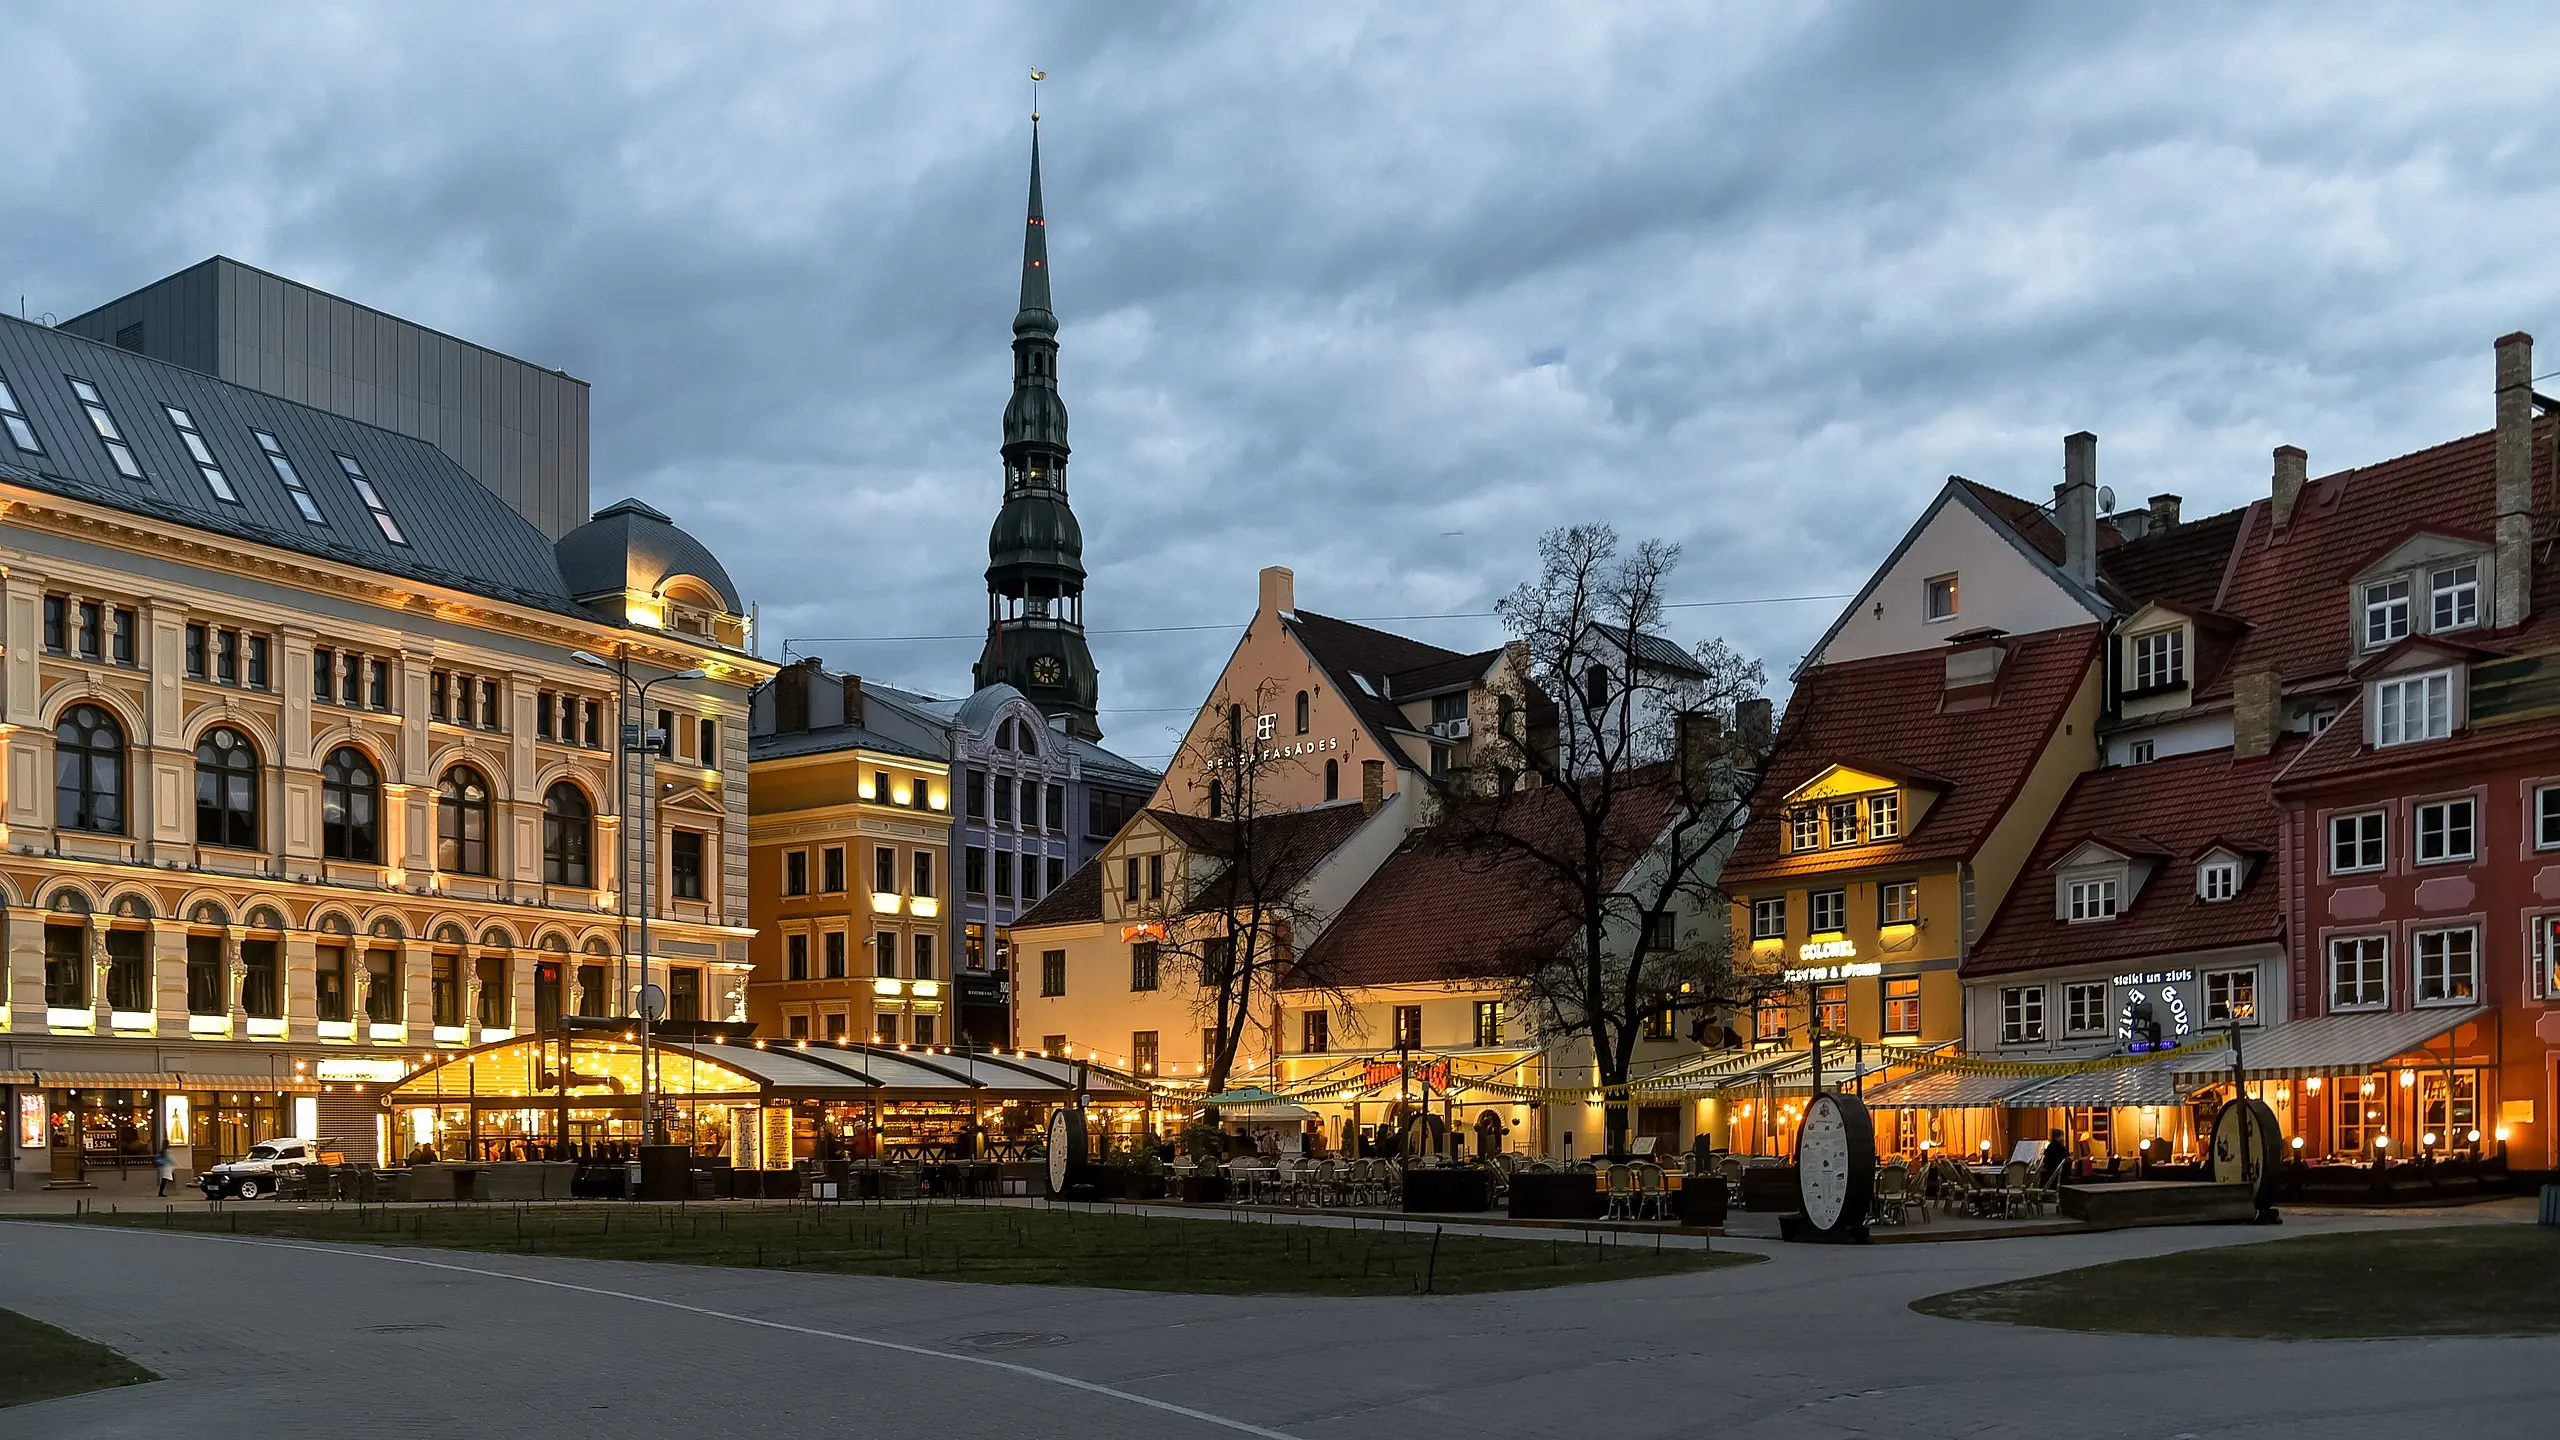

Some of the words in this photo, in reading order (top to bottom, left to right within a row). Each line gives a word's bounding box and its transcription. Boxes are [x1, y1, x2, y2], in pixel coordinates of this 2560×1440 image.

[2146, 973, 2161, 983] un
[2165, 969, 2192, 982] zivis
[2161, 985, 2189, 1036] Govs
